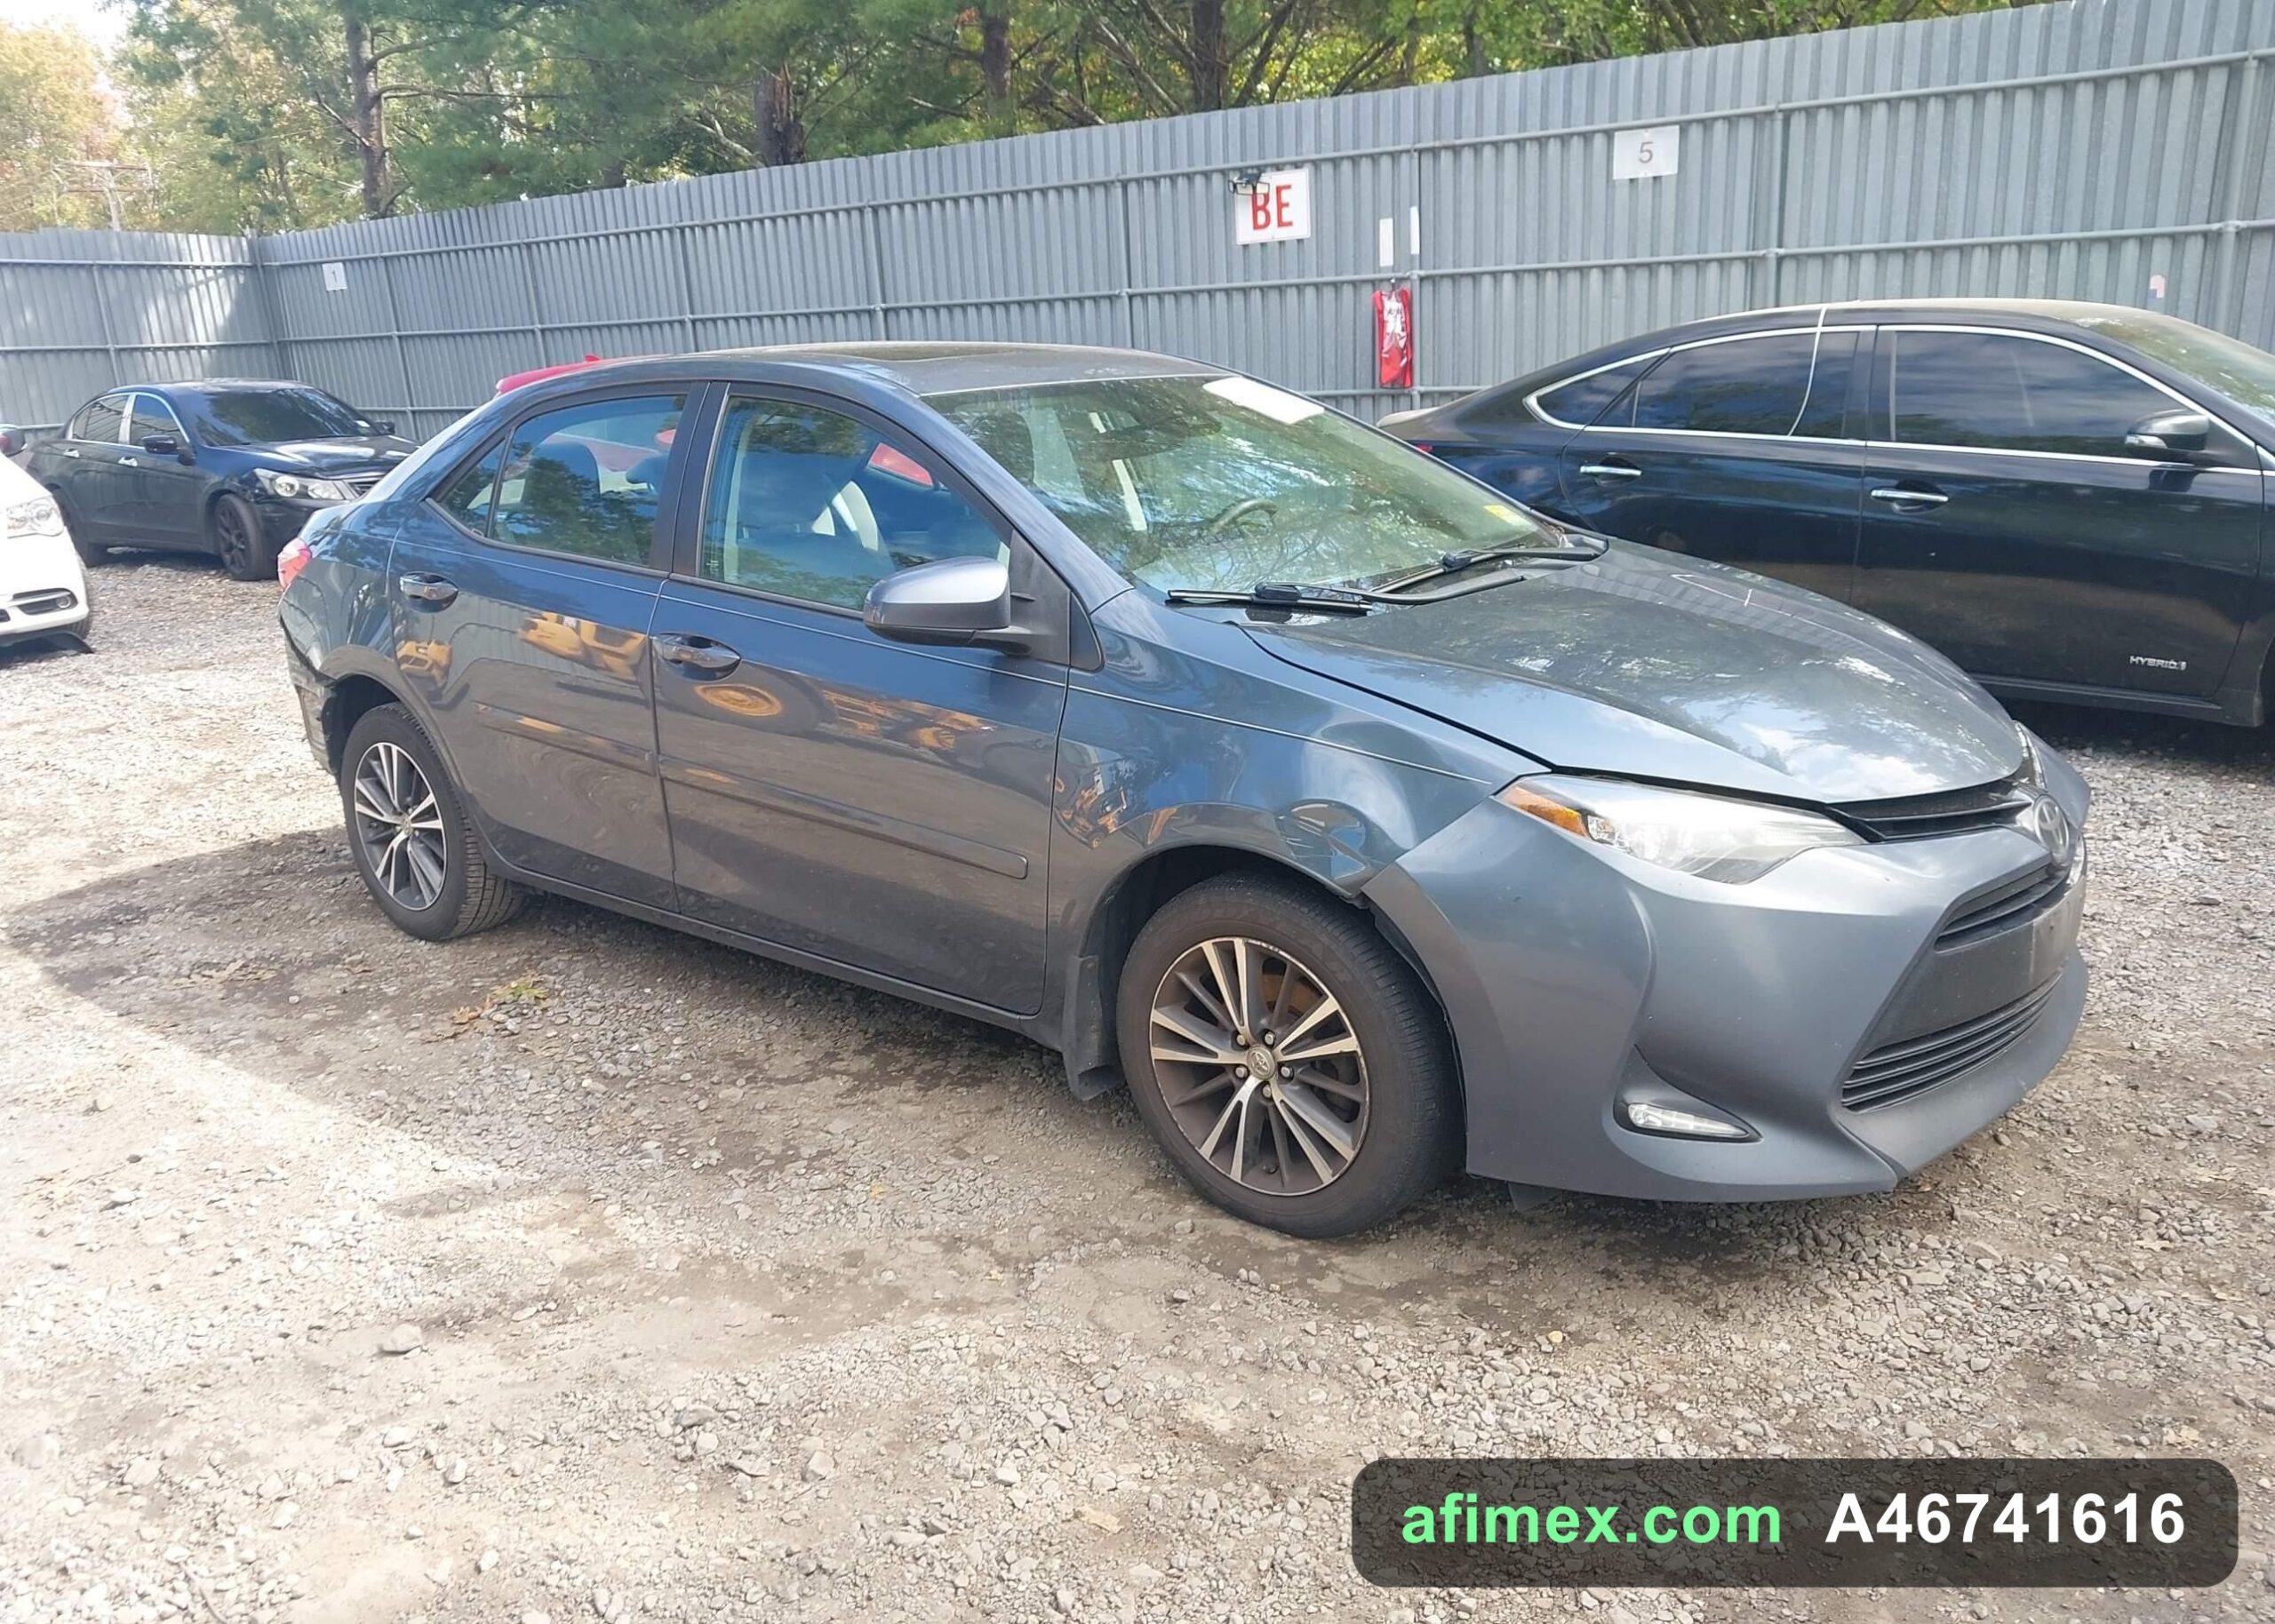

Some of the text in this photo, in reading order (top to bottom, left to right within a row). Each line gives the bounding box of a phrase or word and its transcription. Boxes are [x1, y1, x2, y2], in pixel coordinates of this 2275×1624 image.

[1639, 141, 1654, 163] 5
[1252, 185, 1293, 230] BE
[2129, 656, 2178, 670] HYBRID
